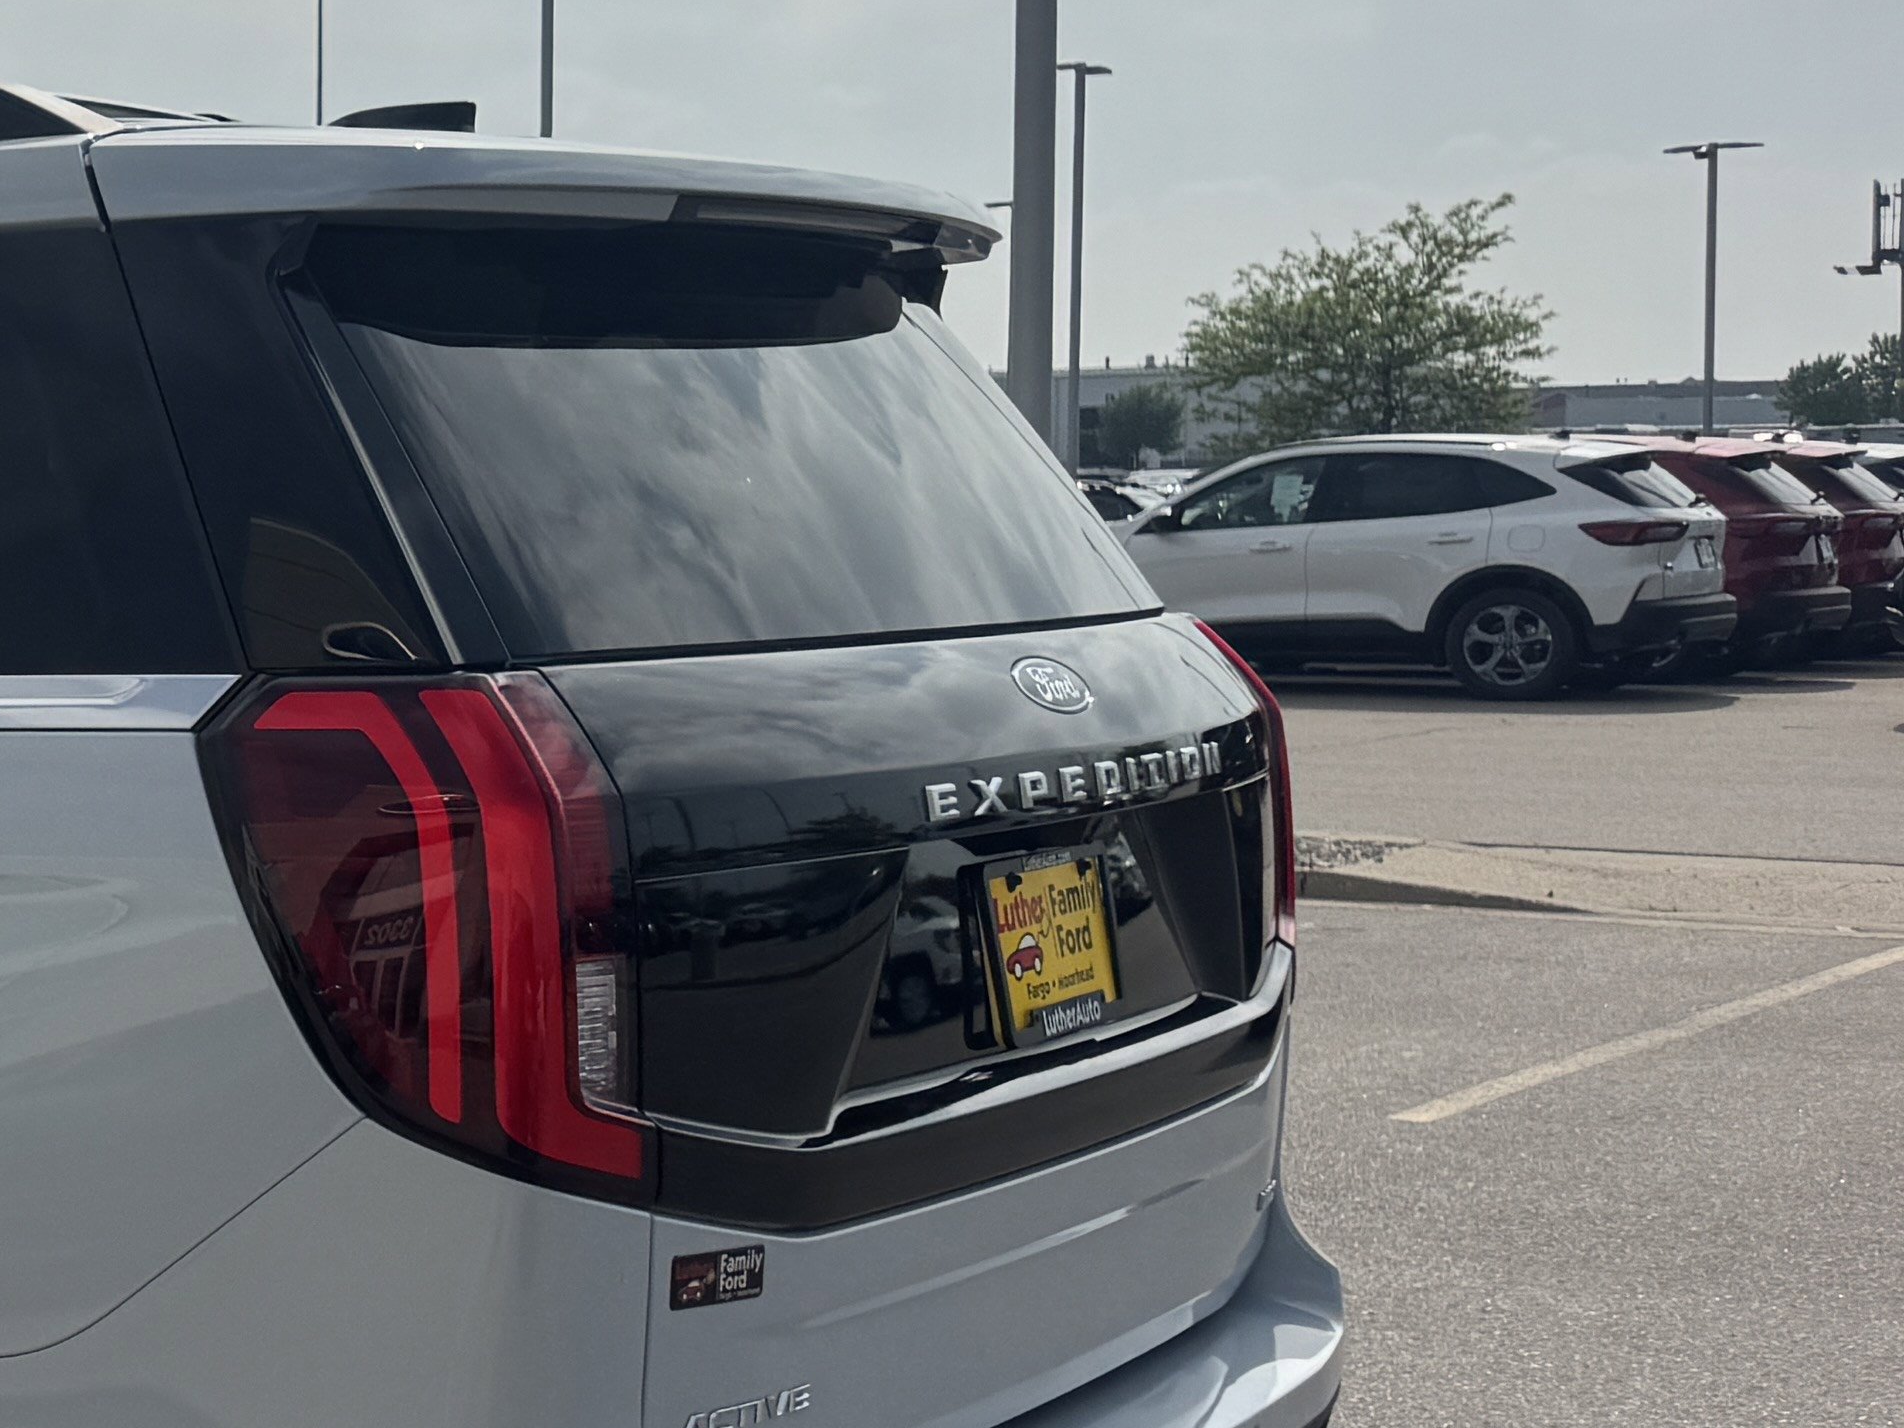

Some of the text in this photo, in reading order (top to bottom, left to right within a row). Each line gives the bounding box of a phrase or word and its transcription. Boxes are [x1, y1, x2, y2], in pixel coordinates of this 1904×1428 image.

[1025, 667, 1081, 702] Ford
[925, 741, 1221, 822] EXPEDITION
[994, 879, 1097, 934] Luther Family
[1057, 918, 1093, 958] Ford
[1027, 980, 1051, 1000] Fargo
[720, 1249, 763, 1274] Family
[720, 1270, 747, 1292] Ford
